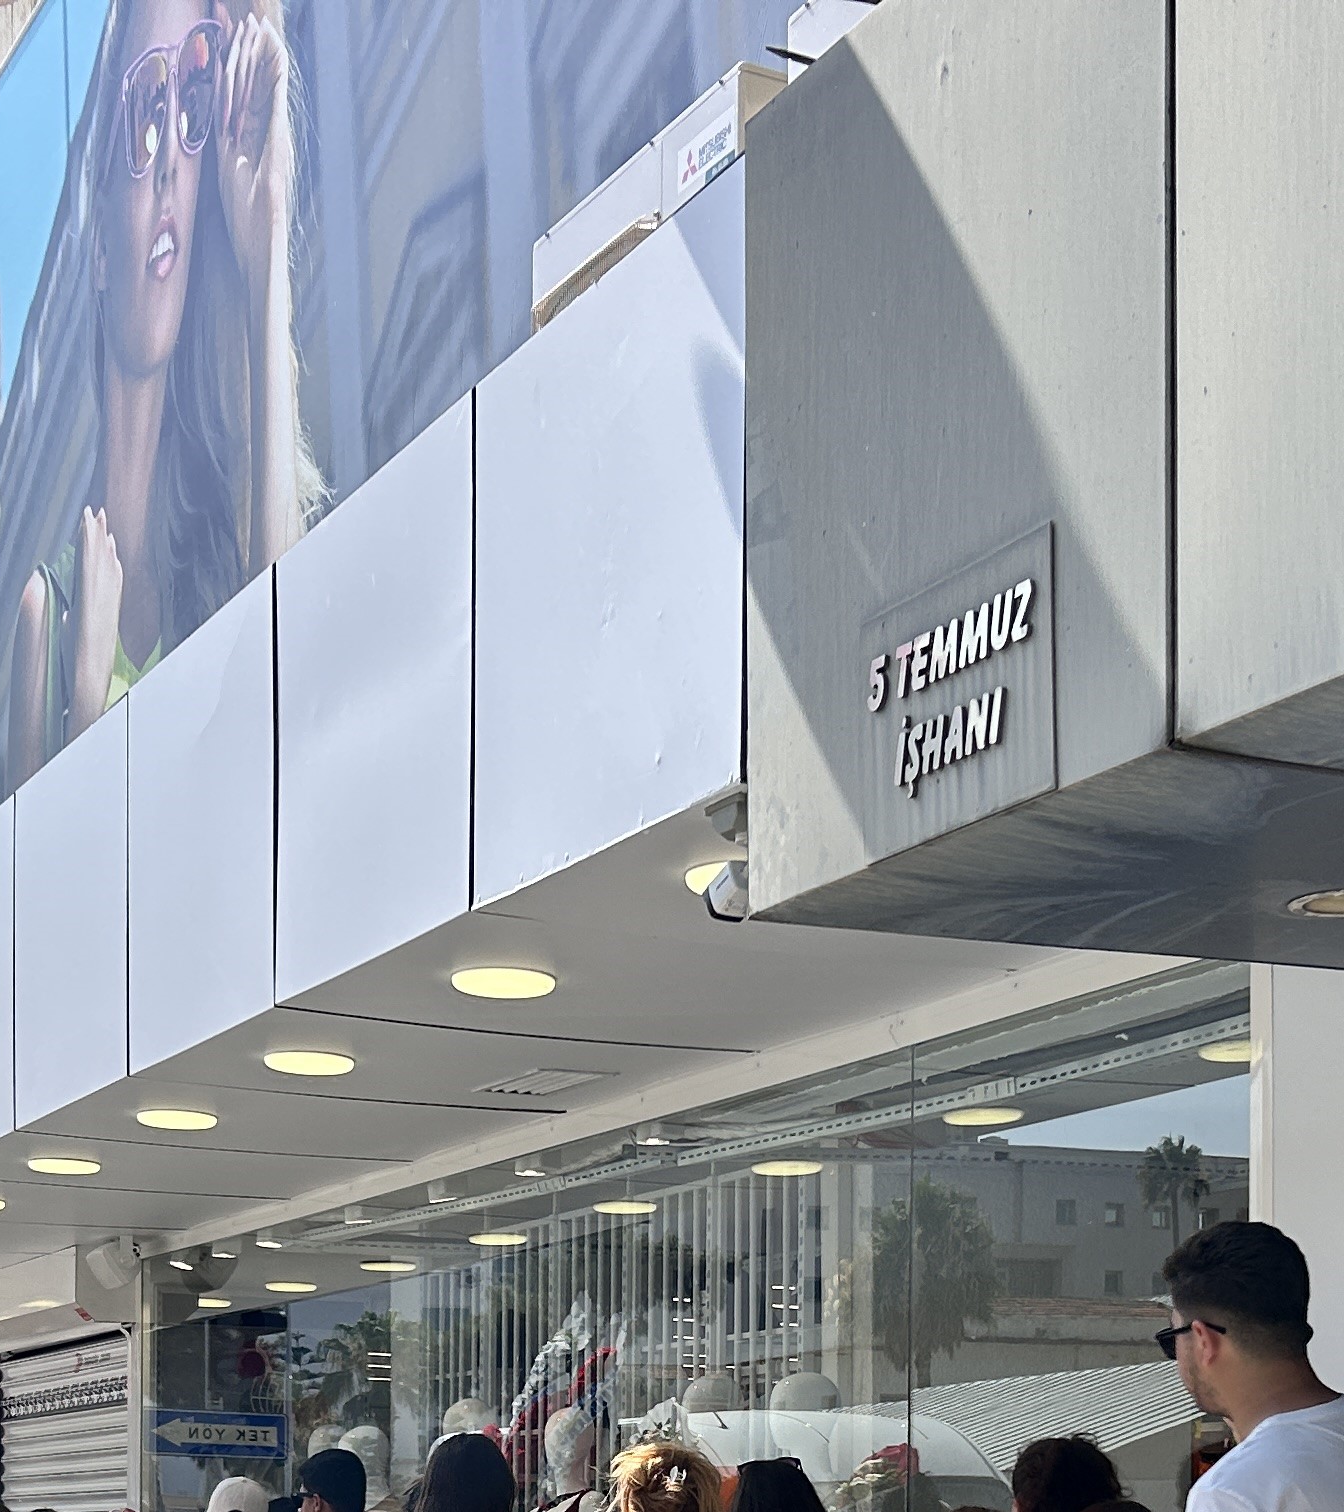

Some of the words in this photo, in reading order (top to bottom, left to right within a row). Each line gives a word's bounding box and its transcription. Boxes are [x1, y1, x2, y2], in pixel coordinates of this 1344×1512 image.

[867, 654, 889, 713] 5
[896, 578, 1035, 699] TEMMUZ
[894, 686, 1007, 799] İŞHANI
